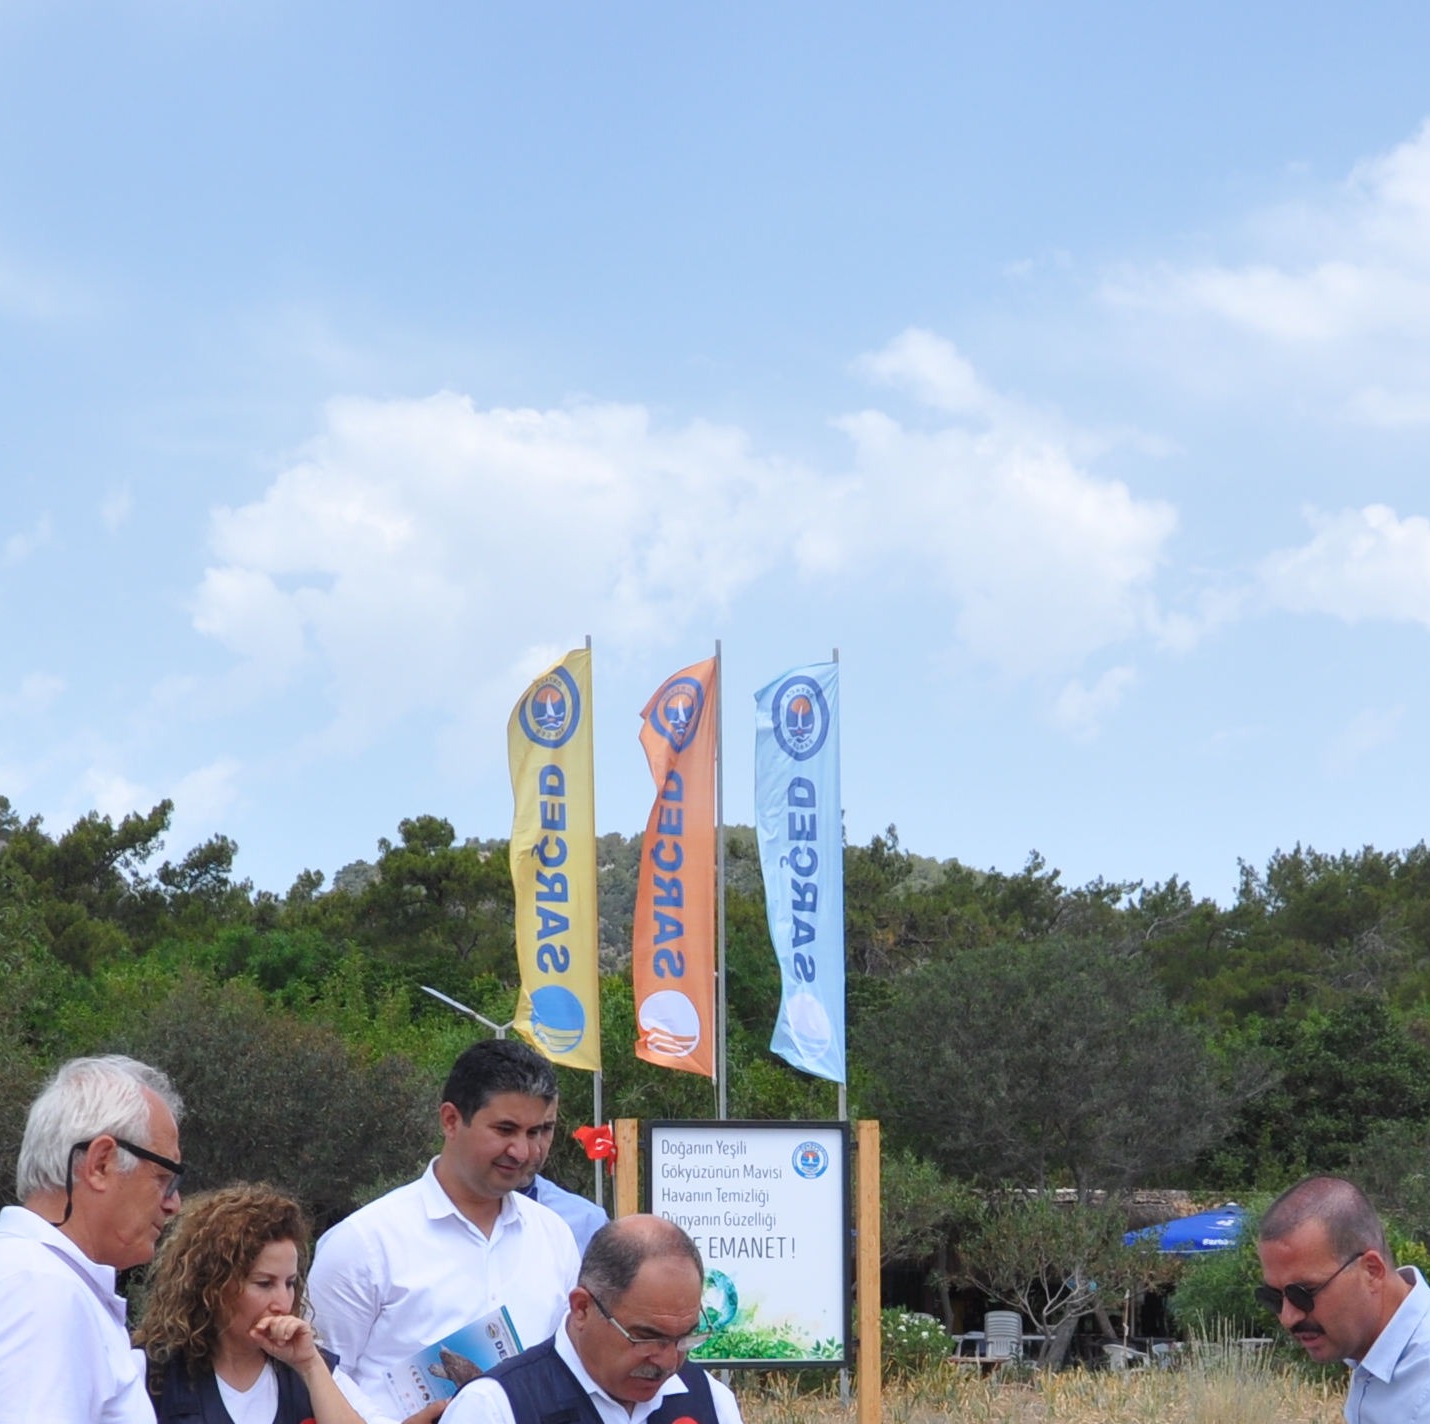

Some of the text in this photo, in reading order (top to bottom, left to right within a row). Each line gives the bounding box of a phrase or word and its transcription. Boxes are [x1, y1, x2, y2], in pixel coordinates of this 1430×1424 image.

[661, 1139, 747, 1160] Doğanın Yeşili
[661, 1163, 783, 1183] Gökyüzünün Mavisi
[661, 1187, 770, 1208] Havanın Temizliği
[723, 1210, 776, 1231] Güzelliği
[709, 1236, 787, 1259] EMANET
